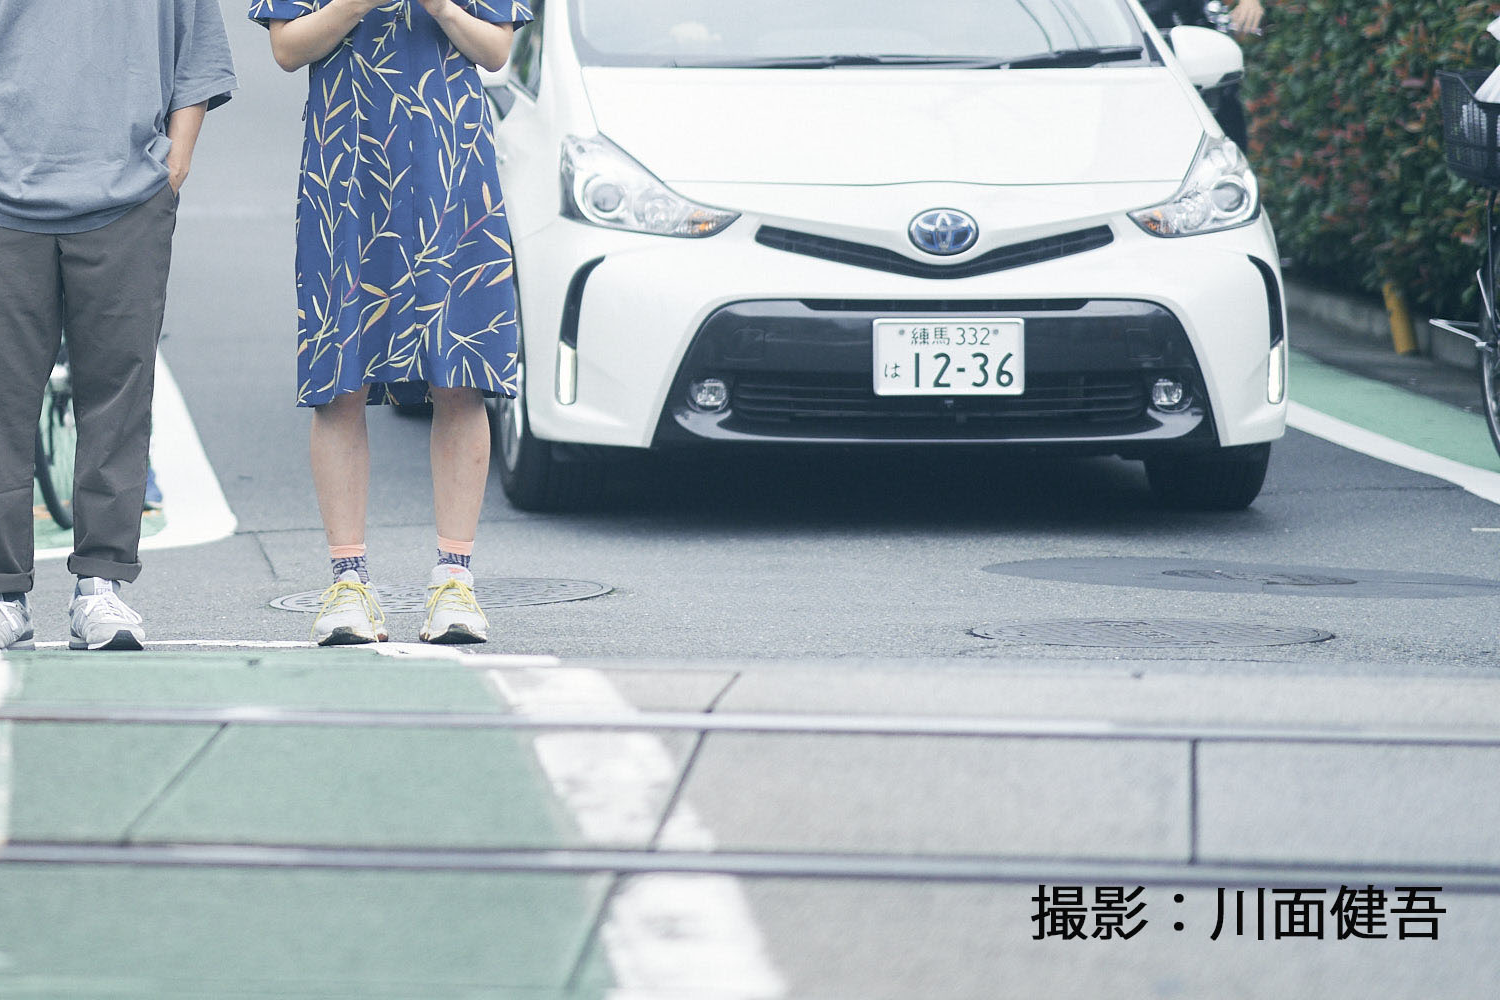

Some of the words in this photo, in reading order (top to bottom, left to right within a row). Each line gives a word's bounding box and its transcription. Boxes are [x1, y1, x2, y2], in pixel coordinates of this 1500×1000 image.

[911, 327, 950, 345] 練馬
[956, 327, 990, 346] 332
[884, 363, 901, 379] は
[914, 352, 1014, 388] 12-36
